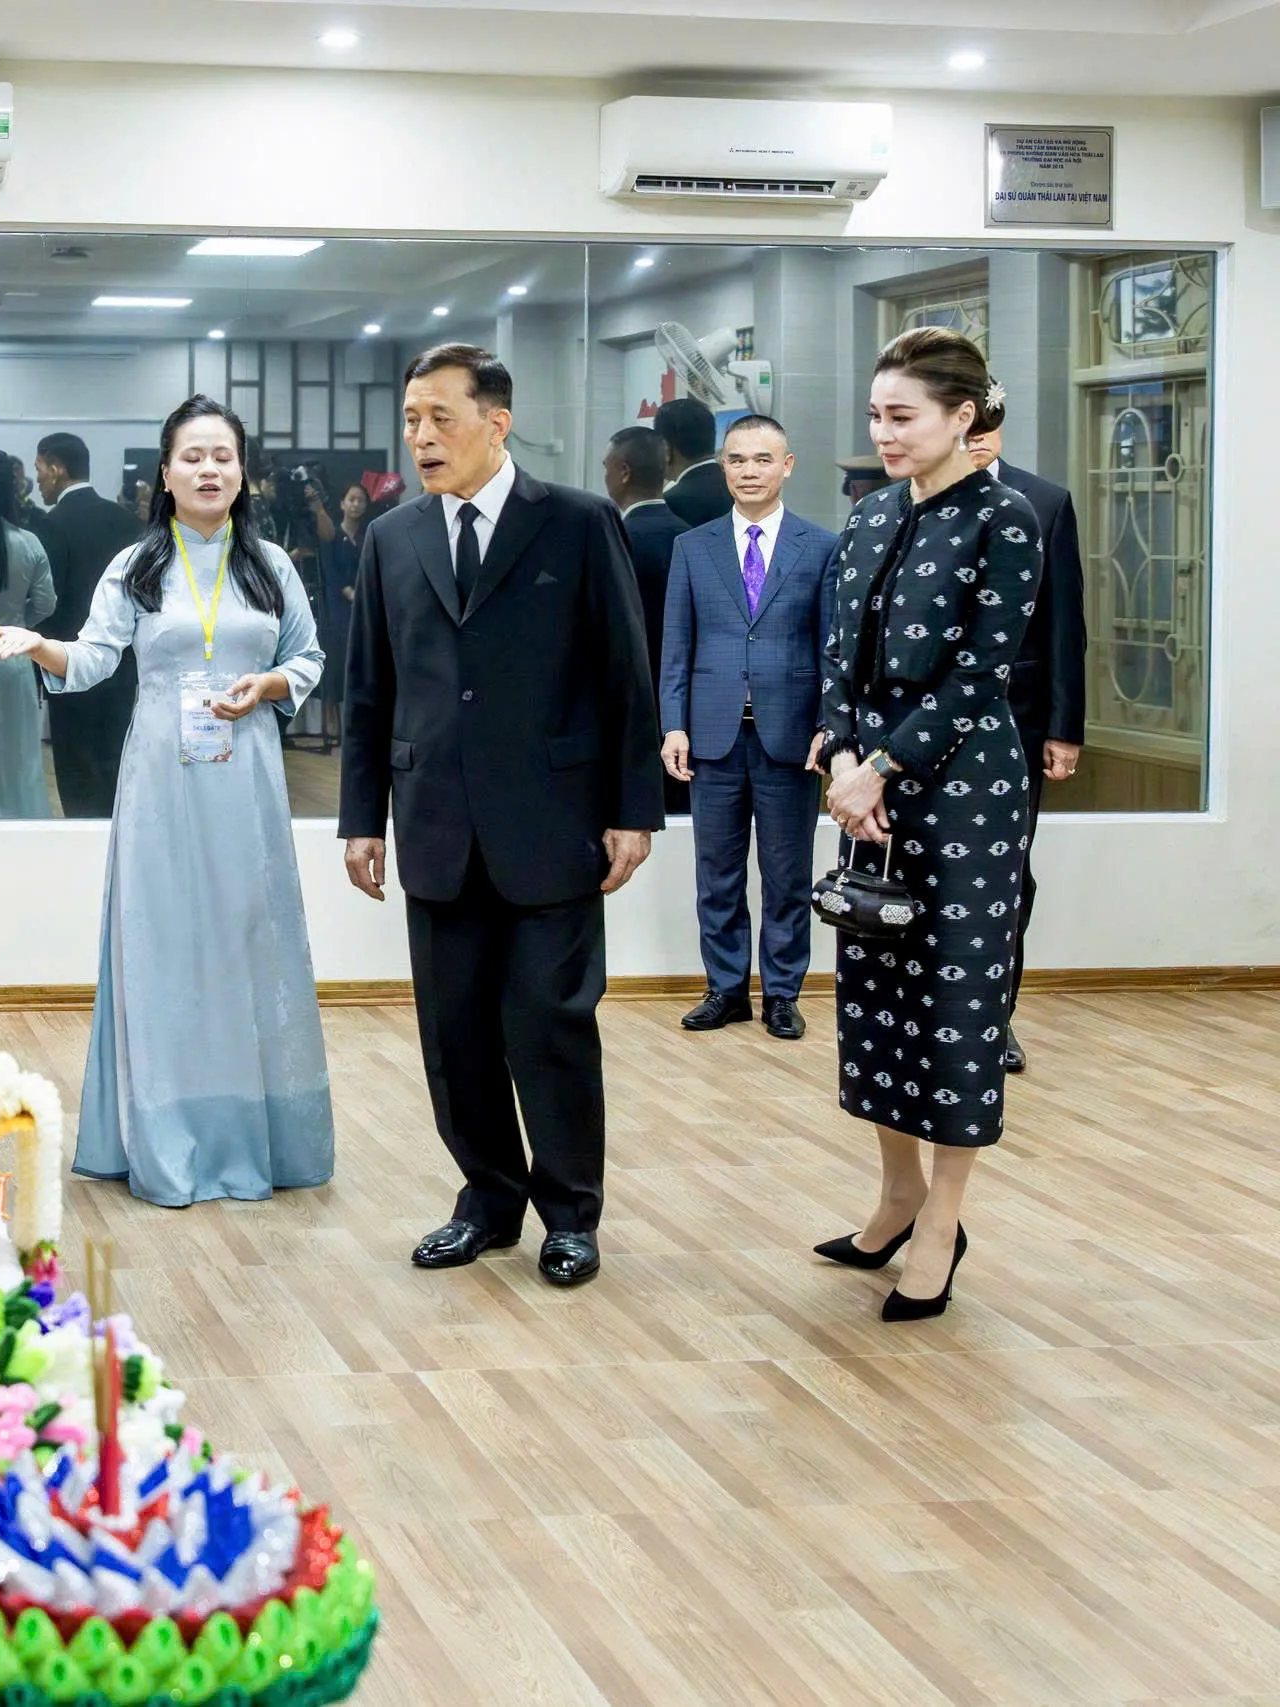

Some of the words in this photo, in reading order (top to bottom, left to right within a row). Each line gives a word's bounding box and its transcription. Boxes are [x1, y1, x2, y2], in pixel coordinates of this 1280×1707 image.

[1037, 190, 1052, 201] THÁI
[1053, 192, 1066, 202] LAN
[1093, 193, 1108, 203] NAM
